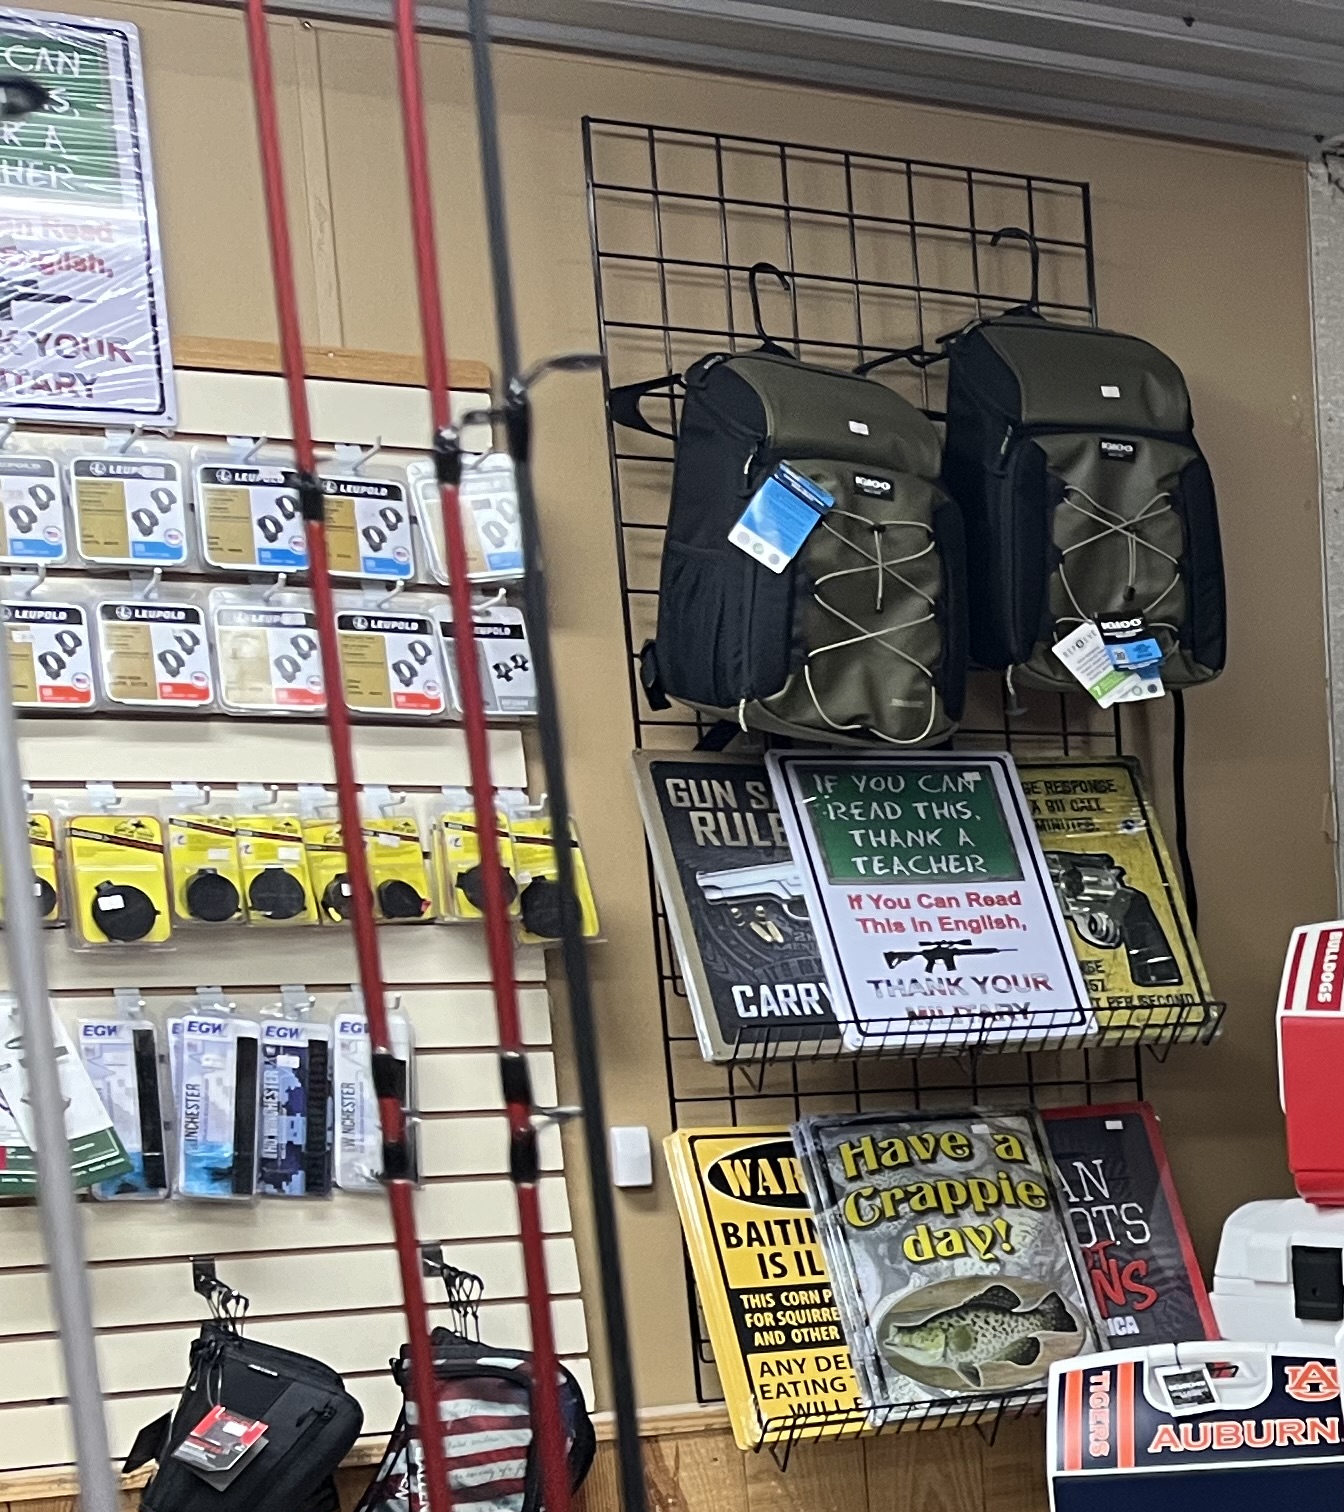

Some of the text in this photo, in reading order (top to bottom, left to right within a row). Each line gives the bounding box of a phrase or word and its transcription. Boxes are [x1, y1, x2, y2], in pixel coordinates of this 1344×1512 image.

[5, 45, 80, 76] CAN
[28, 330, 133, 363] YOUR
[340, 483, 388, 497] LEUPOLD
[15, 610, 68, 621] LEUPOLD
[134, 608, 186, 621] LEUPOLD
[371, 619, 419, 631] LEUPOLD
[1101, 618, 1142, 630] IGLOO
[473, 626, 511, 637] EUPOLD
[666, 778, 737, 808] GUN
[813, 774, 976, 793] IF YOU CAN
[1046, 779, 1118, 796] RESPONSE
[828, 801, 902, 821] READ
[1070, 797, 1105, 813] CALL
[689, 811, 790, 847] RULE
[849, 827, 976, 848] THANK A
[851, 855, 988, 876] TEACHER
[847, 890, 1022, 910] If You Can Read
[856, 914, 1027, 935] This In English,
[1317, 930, 1344, 1004] BULLDOGS
[866, 974, 1054, 998] THANK YOUR
[1139, 994, 1194, 1008] SECOND
[906, 1002, 1031, 1027] MILITARY
[838, 1130, 1026, 1179] Have a
[843, 1170, 1049, 1229] Crappie
[721, 1218, 817, 1249] BAITI
[902, 1217, 1014, 1263] day!
[757, 1252, 789, 1279] IS
[740, 1293, 775, 1310] THIS
[781, 1290, 818, 1308] CORN
[745, 1307, 841, 1328] FOR SQUIRRE
[754, 1326, 840, 1347] AND OTHER
[759, 1357, 808, 1378] ANY
[759, 1376, 848, 1401] EATING
[789, 1397, 838, 1417] WILL
[1088, 1370, 1111, 1458] TIGERS
[1147, 1416, 1341, 1455] AUBURN
